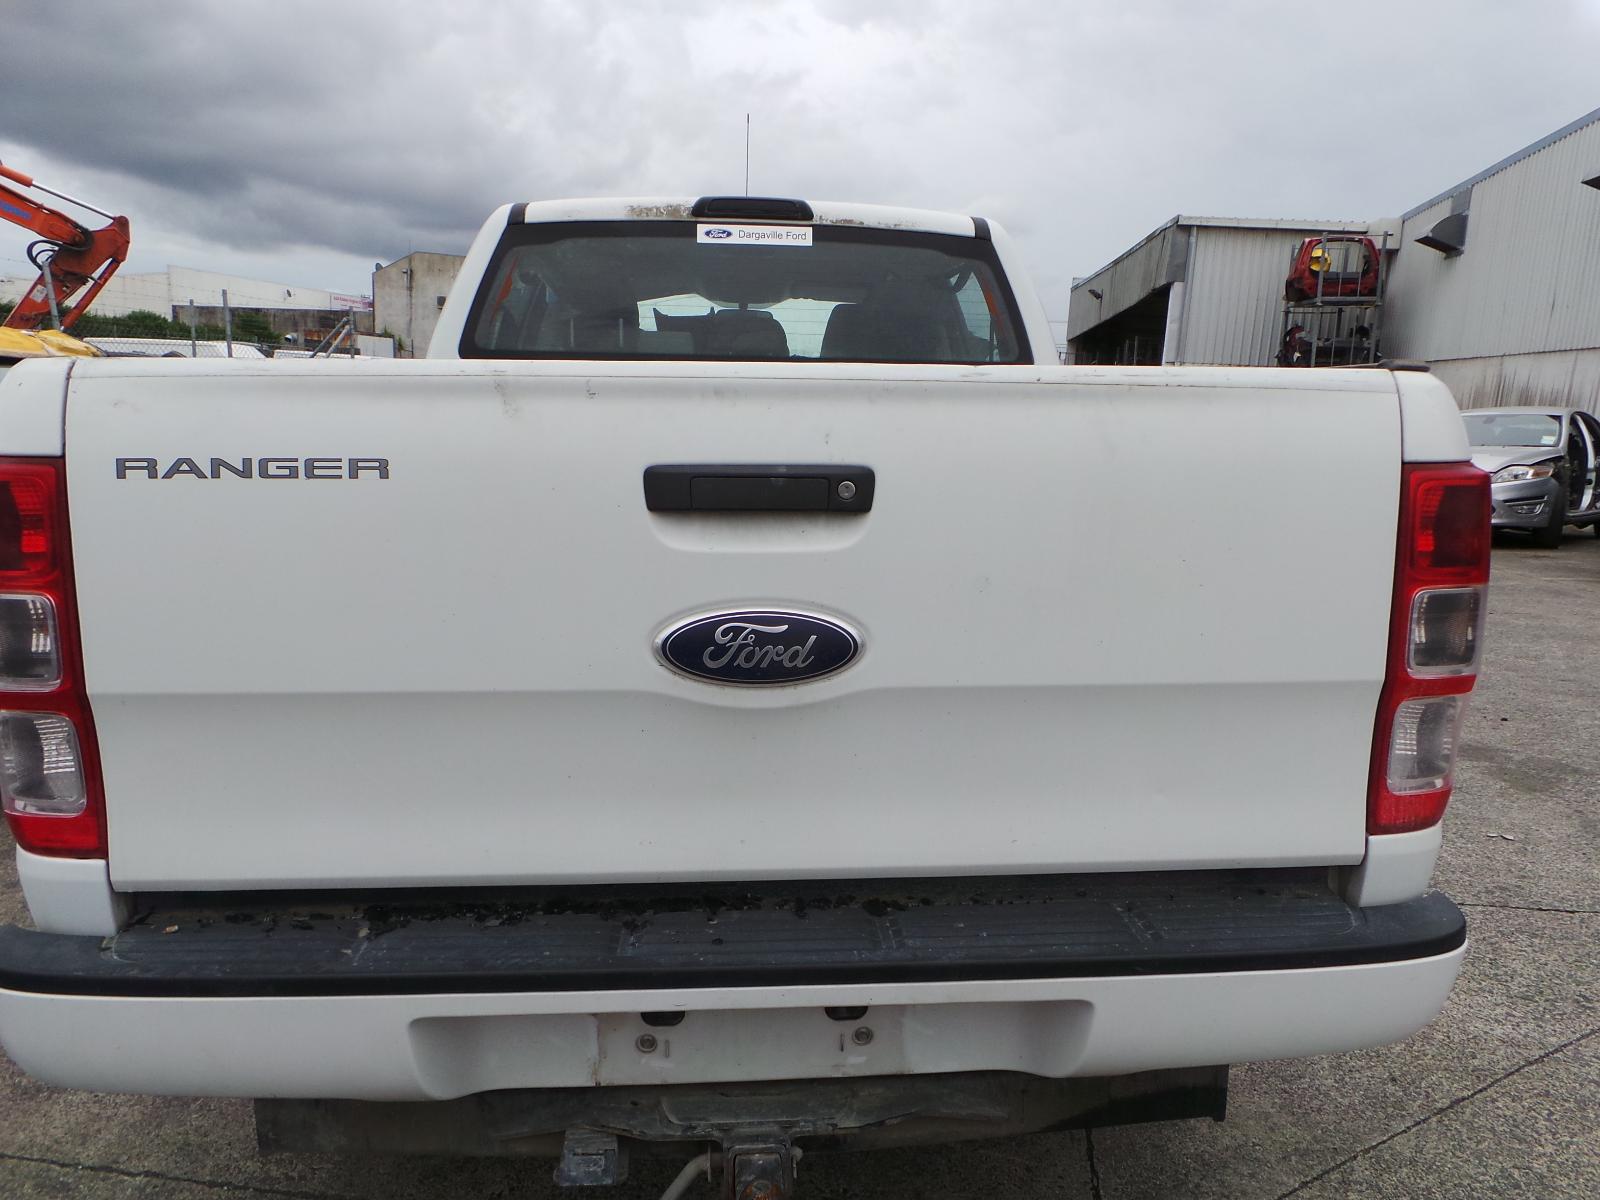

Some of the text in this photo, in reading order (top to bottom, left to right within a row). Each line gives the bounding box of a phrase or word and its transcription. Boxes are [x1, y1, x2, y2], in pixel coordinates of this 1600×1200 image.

[738, 230, 807, 241] Dargaville Ford
[115, 457, 390, 480] RANGER
[703, 622, 818, 669] Ford
